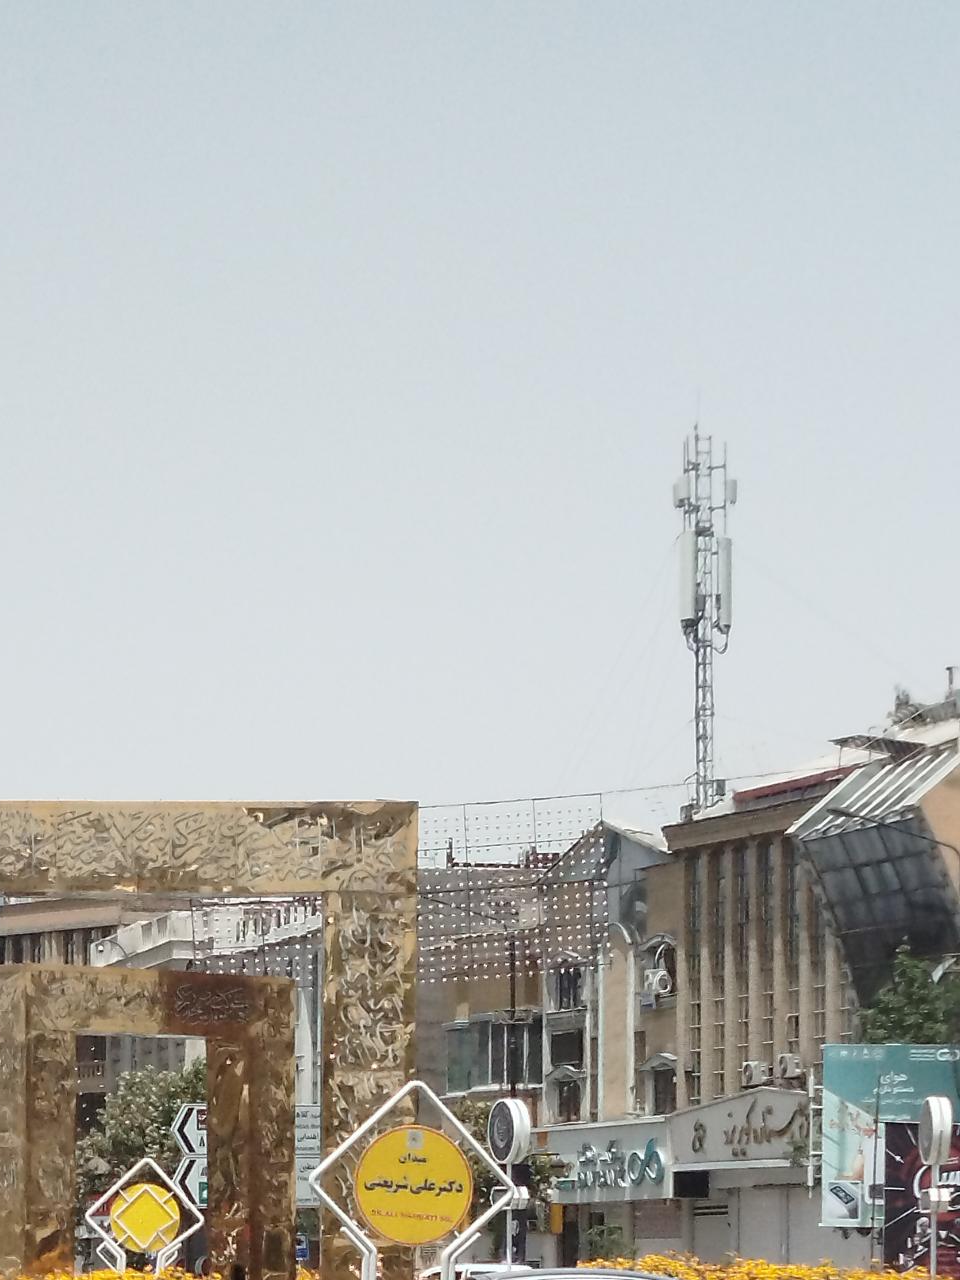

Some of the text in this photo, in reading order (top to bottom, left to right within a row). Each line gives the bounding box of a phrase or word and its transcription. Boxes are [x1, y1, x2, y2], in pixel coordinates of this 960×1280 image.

[398, 1153, 427, 1164] میدان
[364, 1175, 463, 1196] دکتر علی شریعتی
